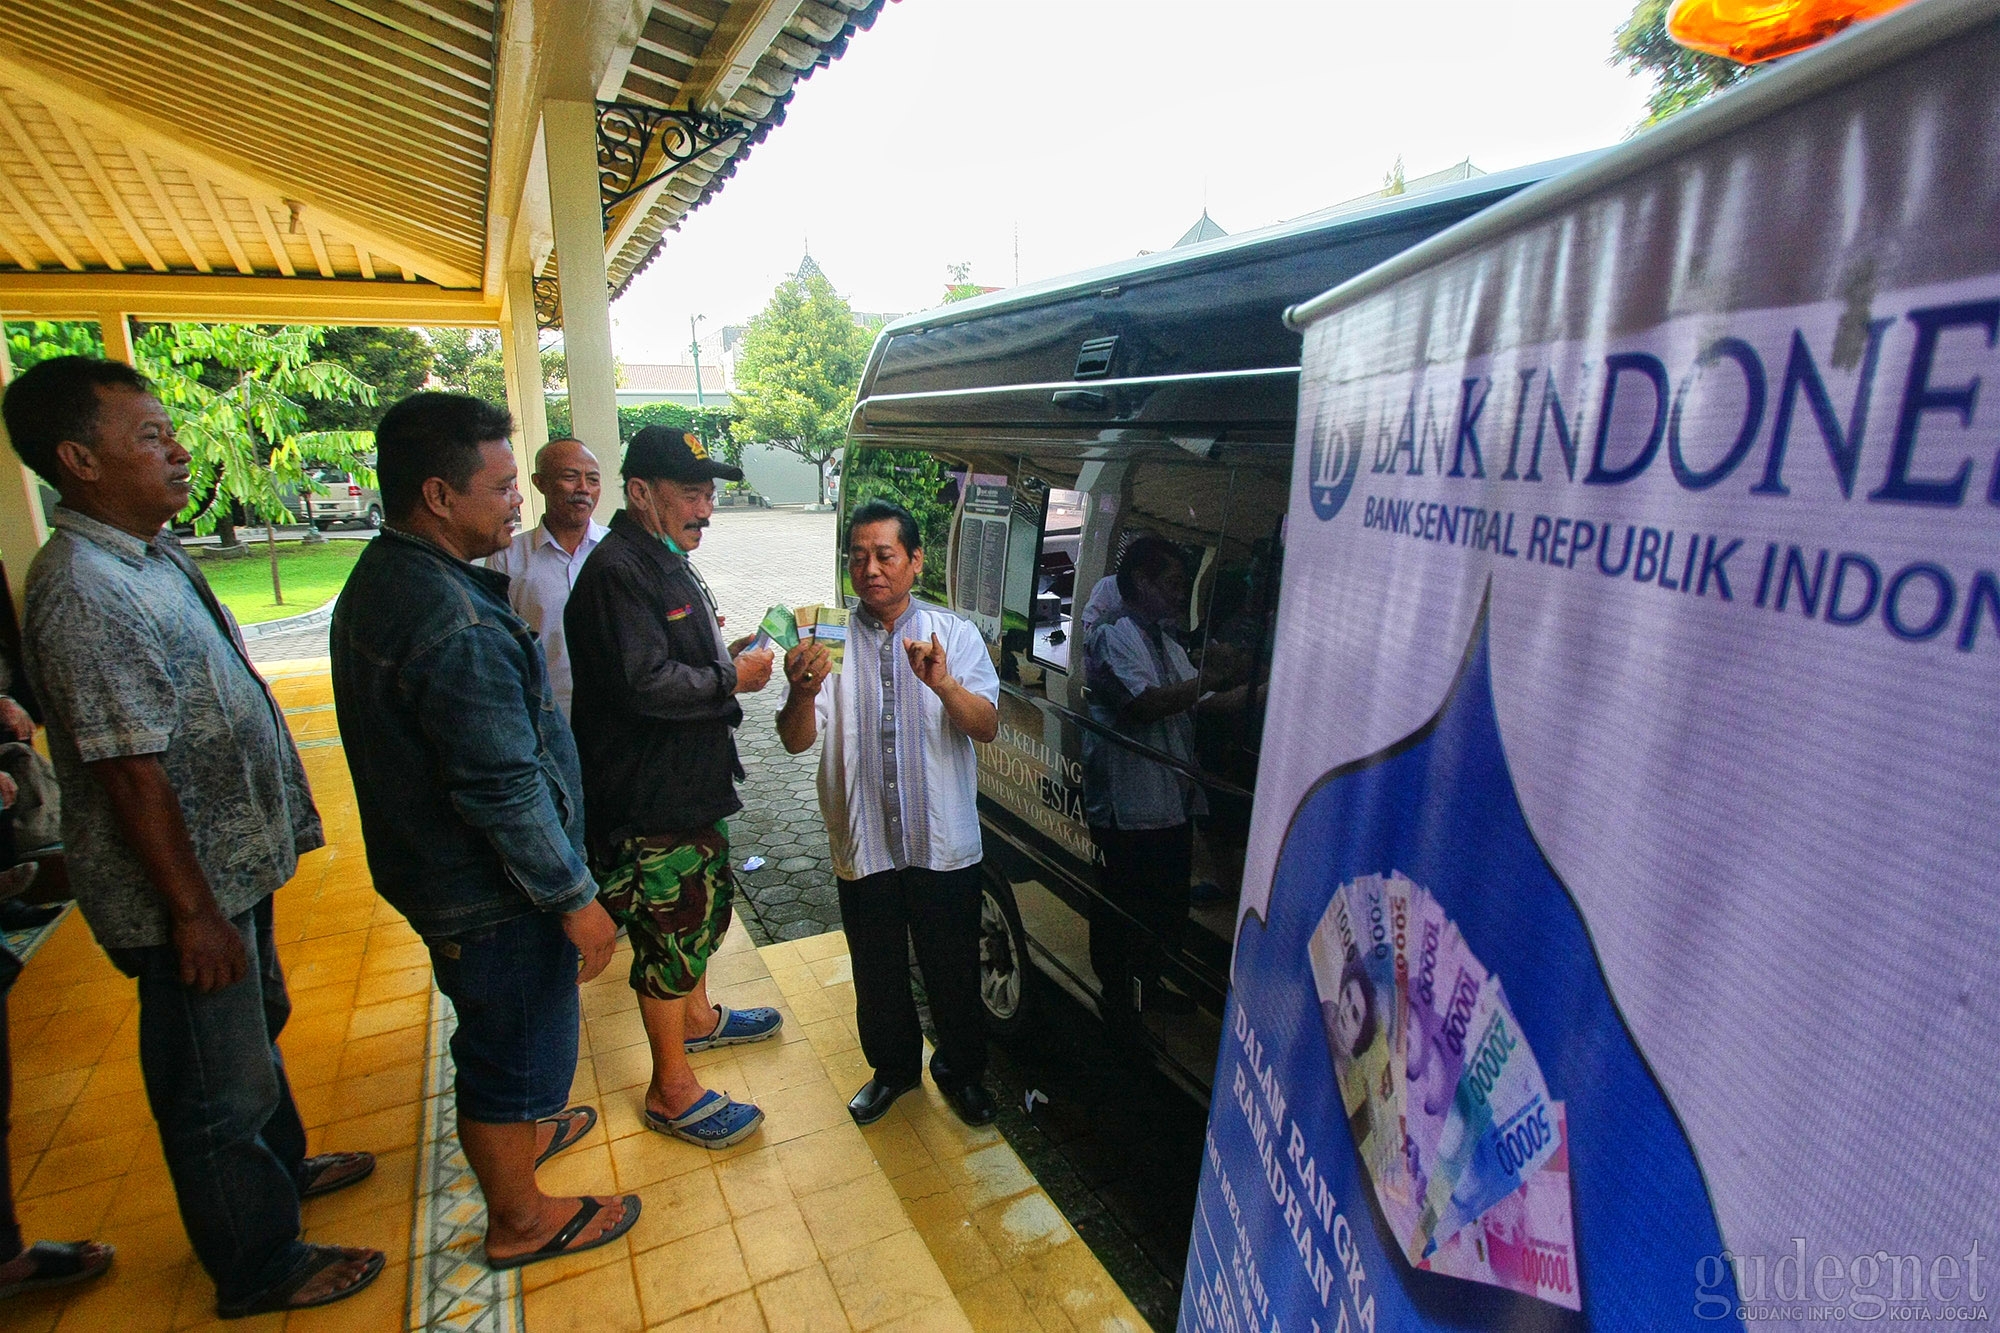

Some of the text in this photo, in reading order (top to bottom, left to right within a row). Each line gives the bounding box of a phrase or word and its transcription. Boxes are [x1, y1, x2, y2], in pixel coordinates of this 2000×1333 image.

[1371, 376, 1493, 480] BANK
[1501, 296, 2000, 509] INDONE
[1363, 495, 1414, 535] BANK
[1414, 502, 1519, 557] SENTRAL
[1526, 515, 1745, 602] REPUBLIK
[981, 742, 1089, 830] INDONESIA
[1013, 729, 1082, 784] KELILING
[1023, 798, 1106, 868] YOGYAKARTA
[1337, 902, 1357, 963] 1000
[1369, 890, 1388, 961] 2000
[1420, 922, 1440, 1006] 10000
[1446, 976, 1480, 1056] 10000
[1468, 1017, 1517, 1105] 20000
[1235, 1003, 1376, 1333] DALAM RANGKA
[1496, 1104, 1552, 1176] 50000
[1233, 1061, 1334, 1308] RAMADHAN
[1522, 1246, 1572, 1294] 100000
